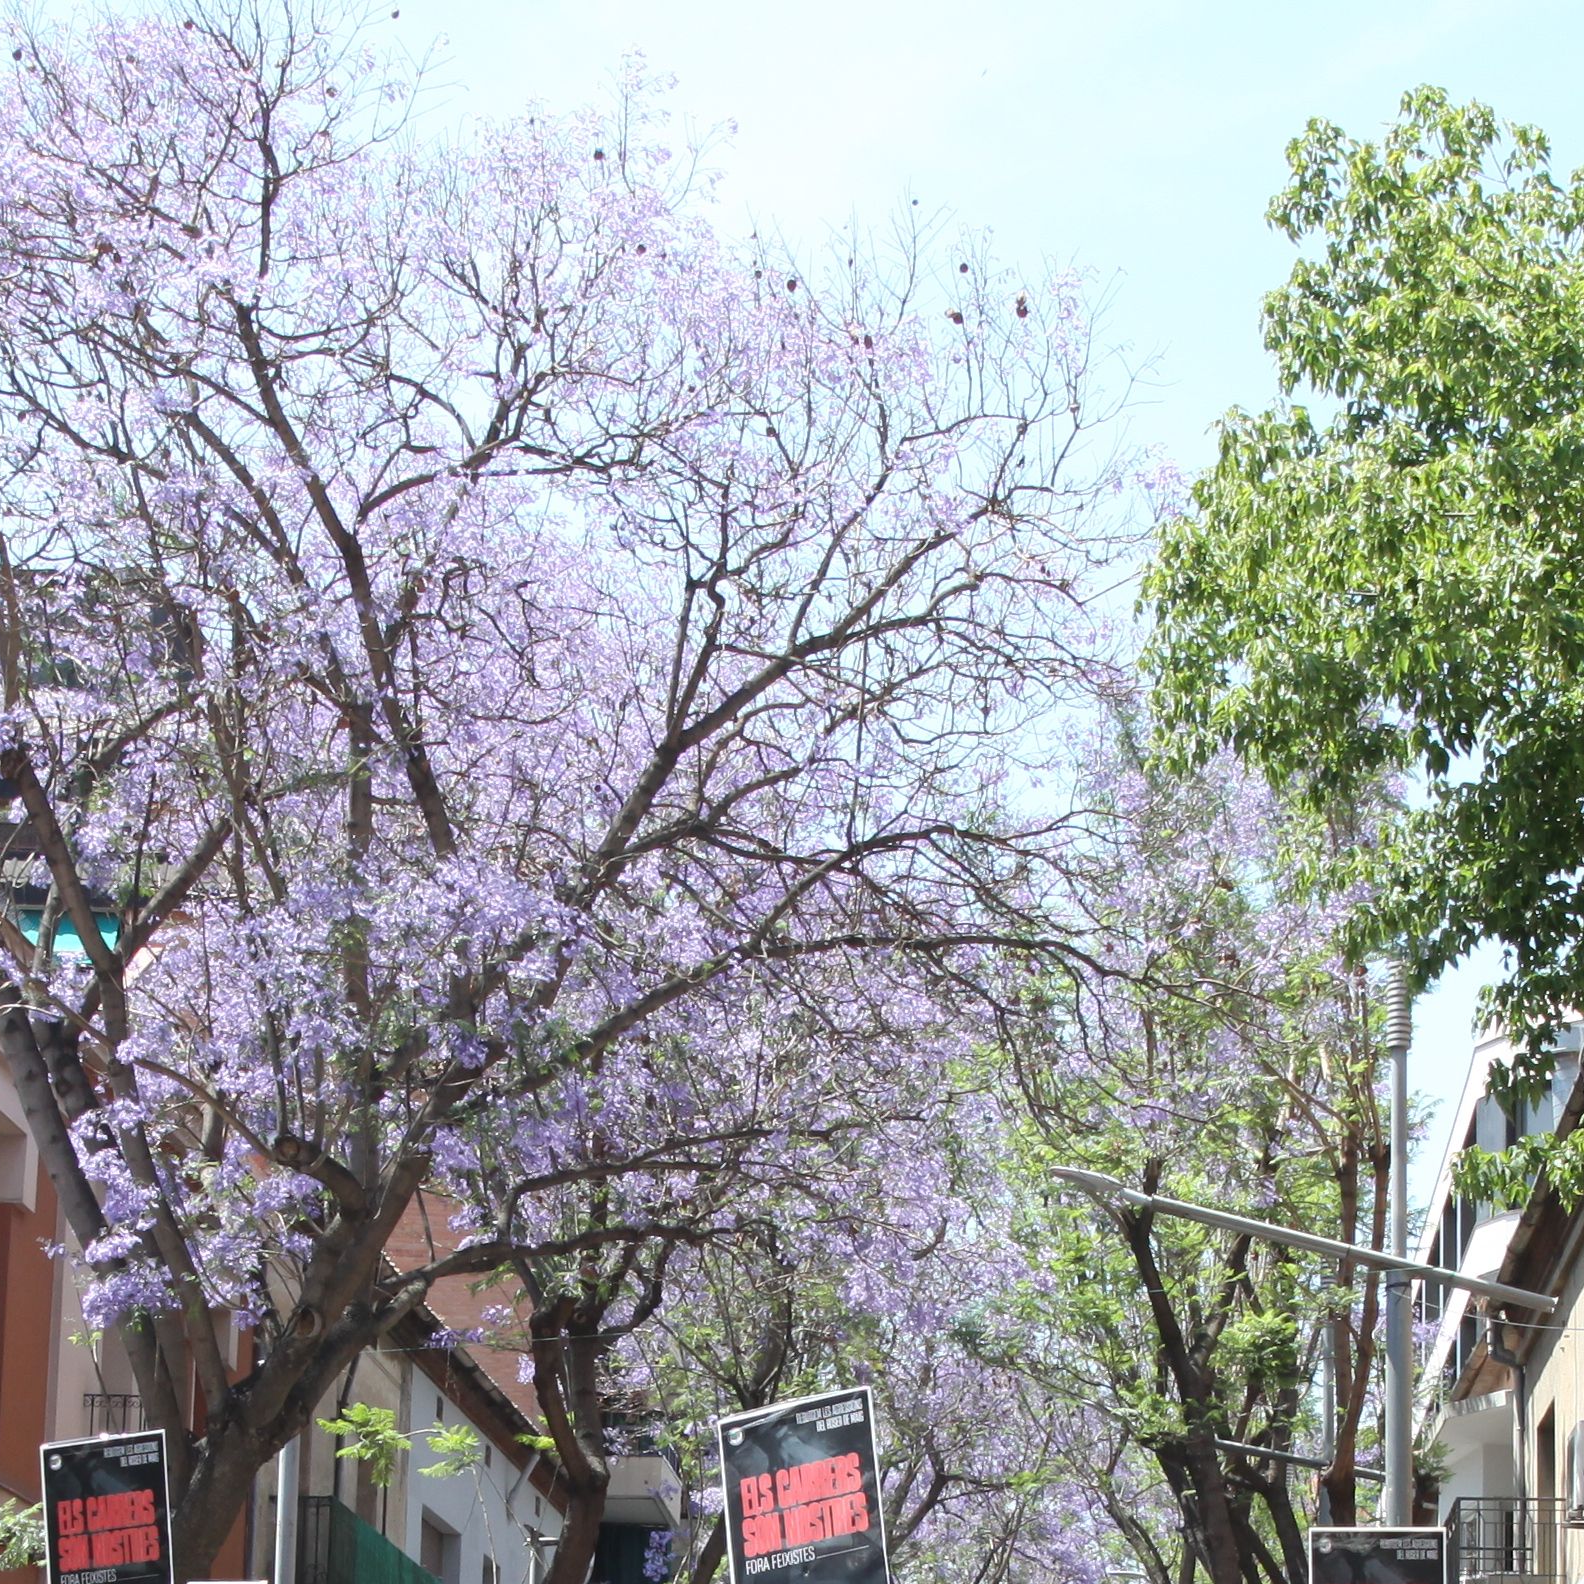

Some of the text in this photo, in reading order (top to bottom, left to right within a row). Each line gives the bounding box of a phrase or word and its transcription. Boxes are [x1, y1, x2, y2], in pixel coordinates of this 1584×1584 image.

[740, 1452, 862, 1517] ELS CARRERS
[57, 1489, 155, 1536] ELS CARRERS
[783, 1492, 870, 1547] NOSTRES
[91, 1525, 160, 1568] NOSTRES
[745, 1546, 816, 1575] FORA FEIXISTES
